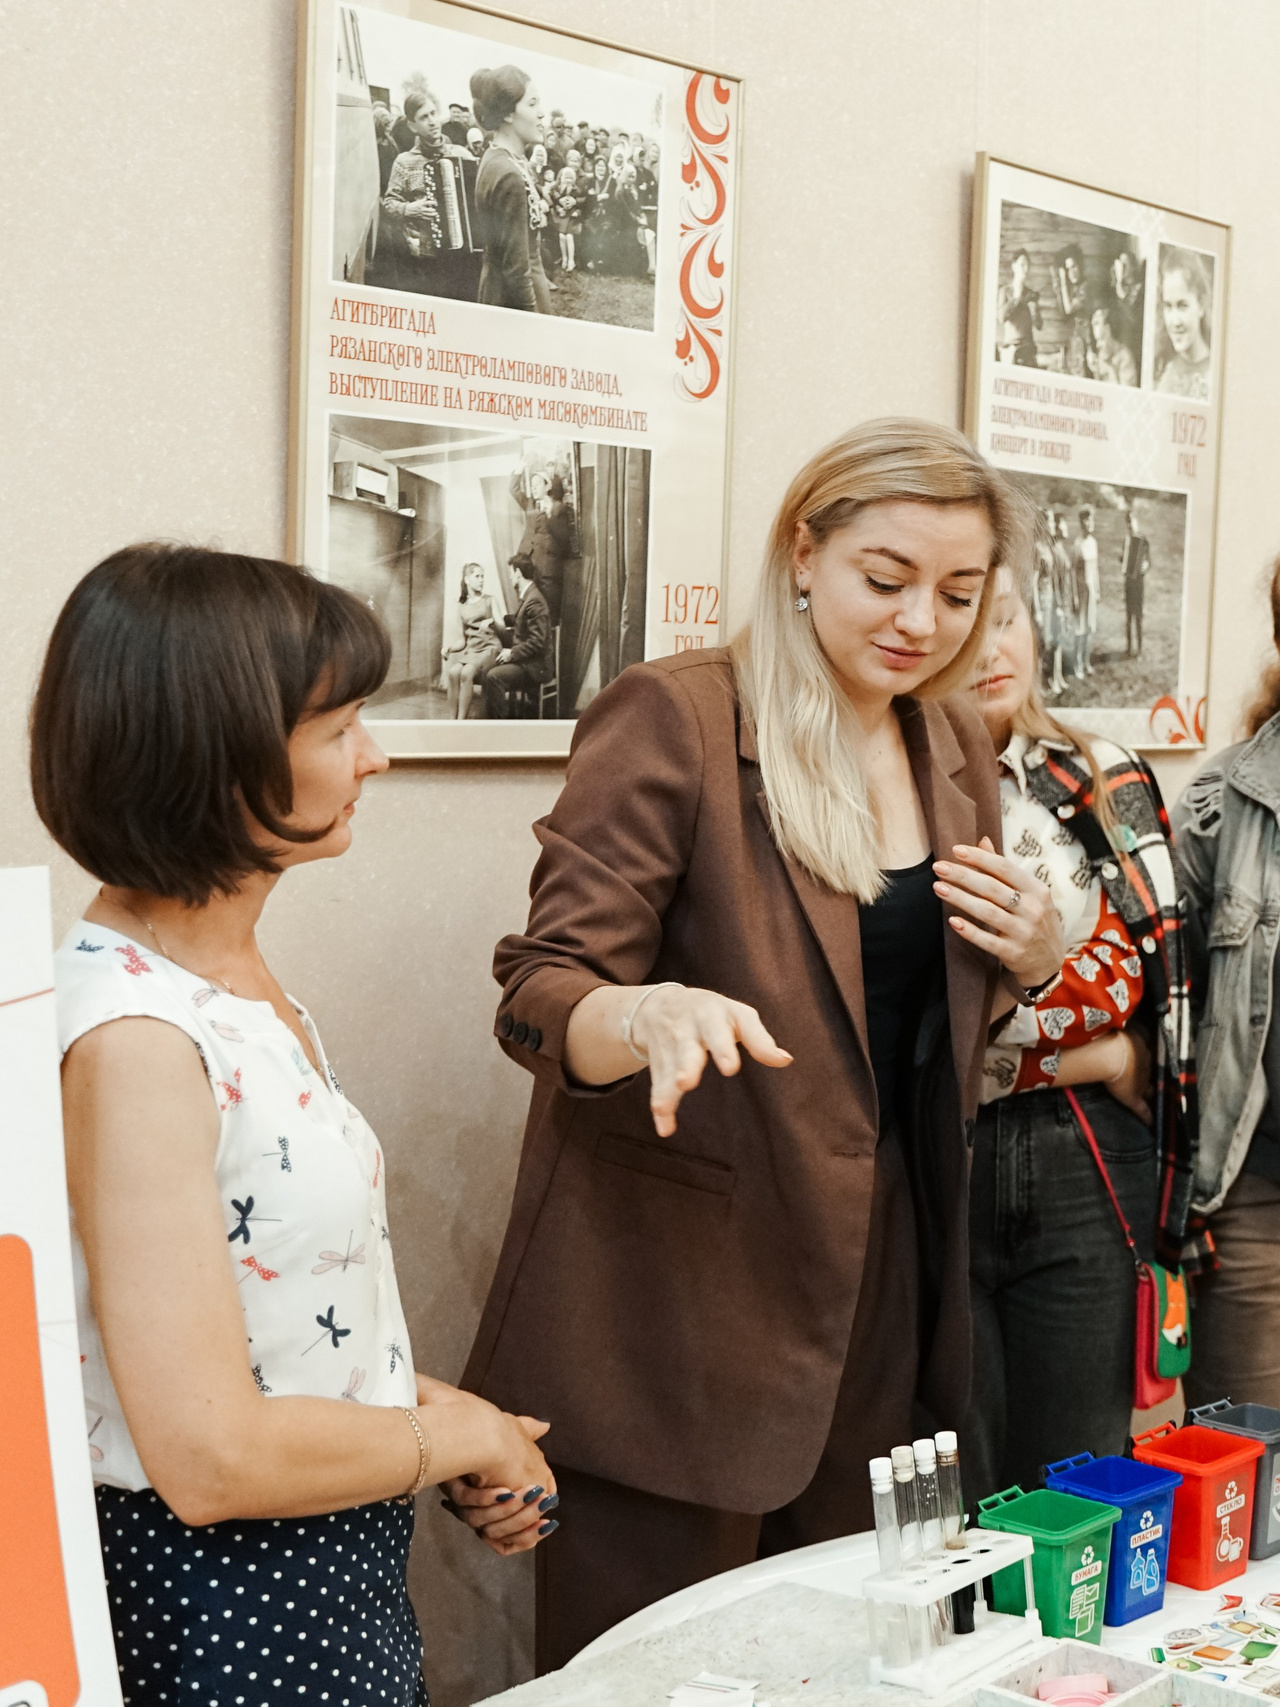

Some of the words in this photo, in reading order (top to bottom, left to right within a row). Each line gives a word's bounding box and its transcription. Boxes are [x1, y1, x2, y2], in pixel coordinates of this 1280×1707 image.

[330, 296, 437, 338] АГИТБРИГАДА
[329, 334, 422, 370] РЯЗАНСКОГО
[427, 347, 567, 388] ЭЛЕКТРОЛАМПОВОГО
[571, 367, 623, 398] ЗАВОДА,
[329, 371, 438, 407] ВЫСТУПЛЕНИЕ
[443, 386, 463, 410] НА
[468, 389, 534, 421] РЯЖСКОМ
[538, 398, 648, 432] МЯСОКОМБИНАТЕ
[1172, 411, 1208, 448] 1972
[1177, 451, 1197, 480] ГОД
[661, 582, 719, 625] 1972
[1219, 1497, 1242, 1514] СТЕКЛО
[1132, 1527, 1161, 1545] ПЛАСТИК
[1074, 1564, 1098, 1582] БУМАГА
